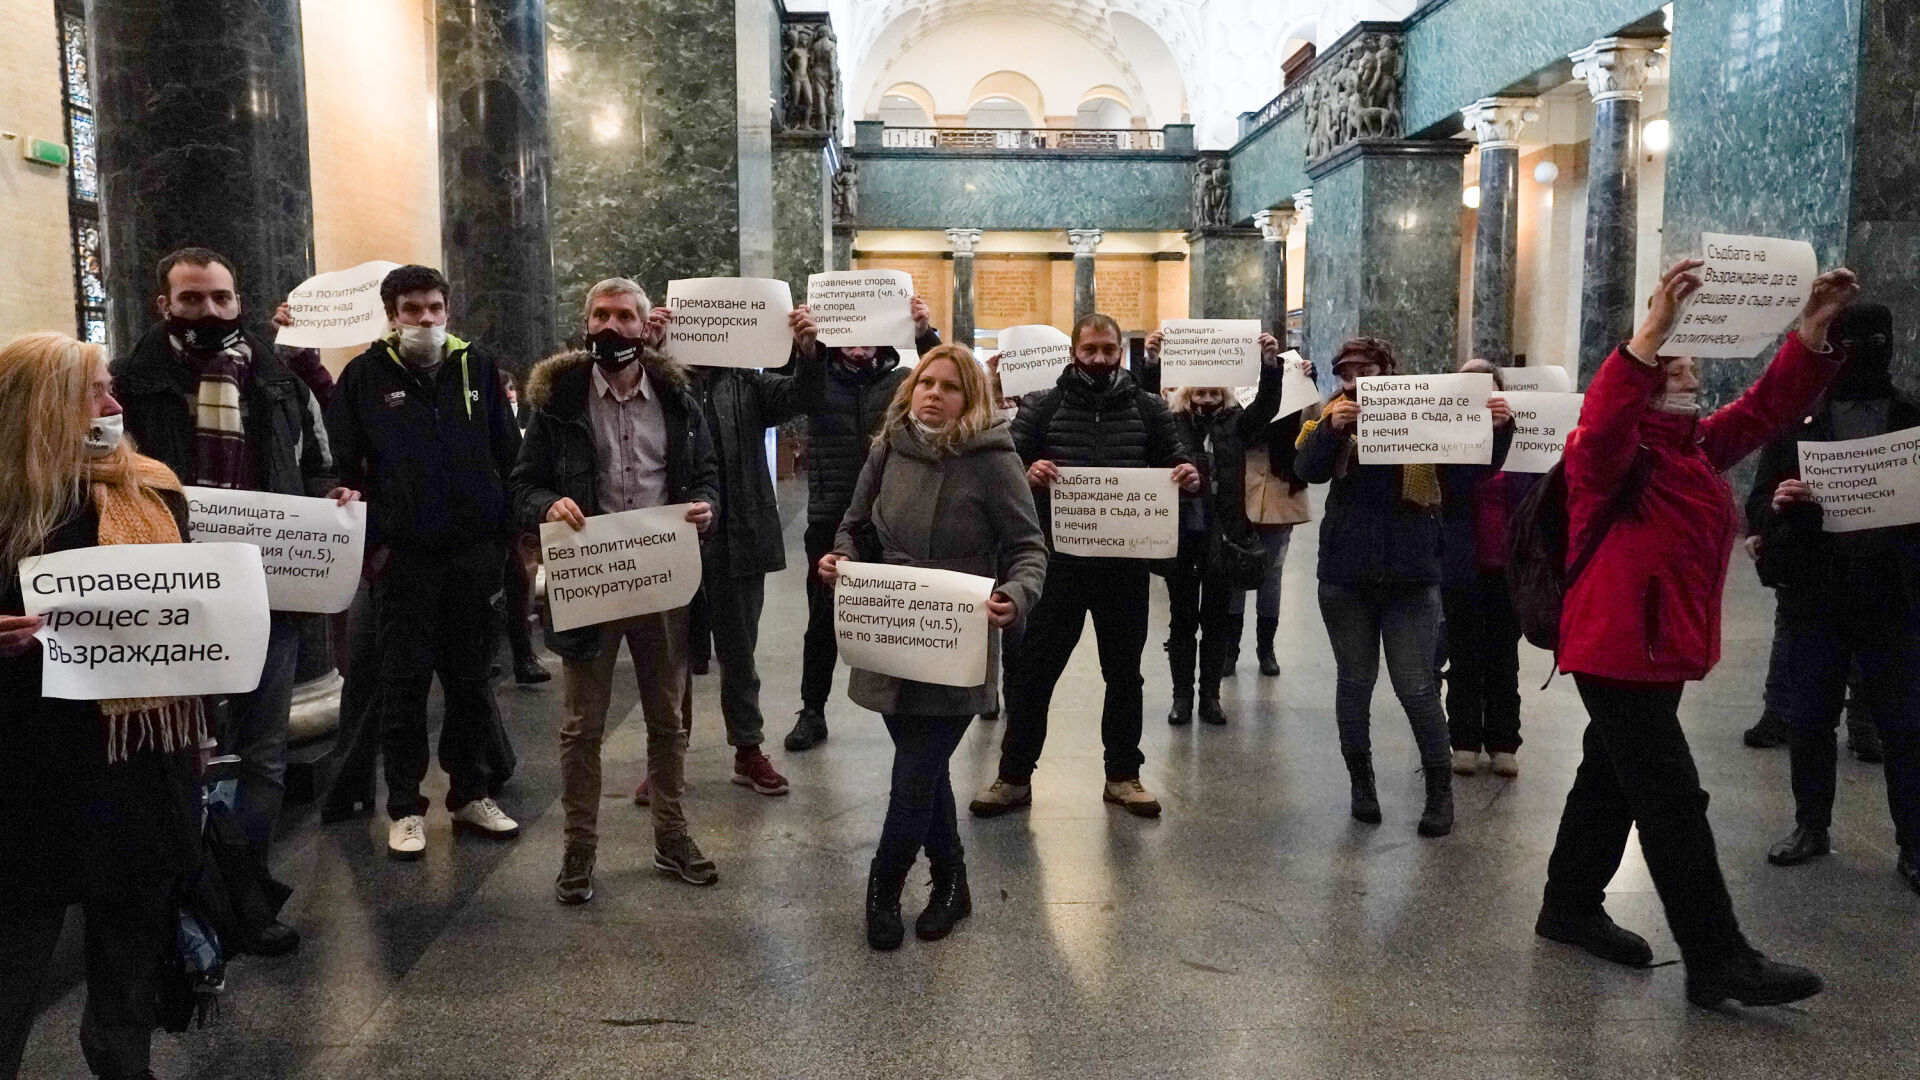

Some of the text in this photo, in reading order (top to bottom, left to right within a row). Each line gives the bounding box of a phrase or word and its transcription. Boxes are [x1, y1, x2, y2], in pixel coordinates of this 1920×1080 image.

[1708, 244, 1766, 262] Съдбата на
[811, 278, 896, 288] Управление според
[1704, 268, 1798, 287] Възраждане да се
[316, 279, 379, 298] политически
[878, 289, 895, 298] (чл.
[670, 298, 766, 310] Премахване на
[1693, 292, 1736, 306] решава
[1738, 296, 1746, 306] в
[1776, 297, 1784, 306] а
[1786, 296, 1800, 307] не
[288, 302, 354, 312] натиск над
[810, 302, 856, 311] Не според
[670, 316, 758, 328] прокурорския
[1684, 314, 1728, 325] в нечия
[1164, 326, 1215, 334] Съдилищата
[670, 332, 729, 342] монопол!
[1164, 336, 1209, 346] решавайте
[1671, 333, 1740, 345] политическа
[1164, 348, 1216, 356] Конституция
[1188, 358, 1243, 366] зависимости!
[1360, 382, 1429, 392] Съдбата на
[1361, 396, 1470, 407] Възраждане да се
[1362, 412, 1481, 423] решава в съда, а не
[1362, 428, 1408, 437] в нечия
[1542, 427, 1556, 436] за
[1362, 443, 1438, 454] политическа
[1803, 446, 1886, 462] Управление
[1805, 458, 1908, 474] Конституцията
[1055, 474, 1118, 486] Съдбата на
[1806, 477, 1877, 490] Не според
[1054, 490, 1157, 502] Възраждане да се
[189, 500, 285, 520] Съдилищата
[1054, 506, 1169, 518] решава в съда, а не
[1824, 506, 1876, 518] тереси.
[1055, 520, 1098, 530] в нечия
[276, 528, 327, 542] делата
[332, 533, 350, 544] по
[1056, 535, 1125, 546] политическа
[548, 532, 677, 561] Без политически
[288, 546, 335, 563] (чл.5),
[264, 564, 330, 579] симости!
[552, 558, 636, 582] натиск над
[32, 572, 221, 597] Справедлив
[554, 570, 672, 602] Прокуратурата!
[840, 574, 917, 591] Съдилищата
[838, 594, 974, 614] решавайте делата по
[158, 608, 190, 626] за
[838, 610, 962, 634] Конституция (чл.5),
[840, 630, 958, 650] не по зависимости!
[47, 637, 230, 669] Възраждане.
